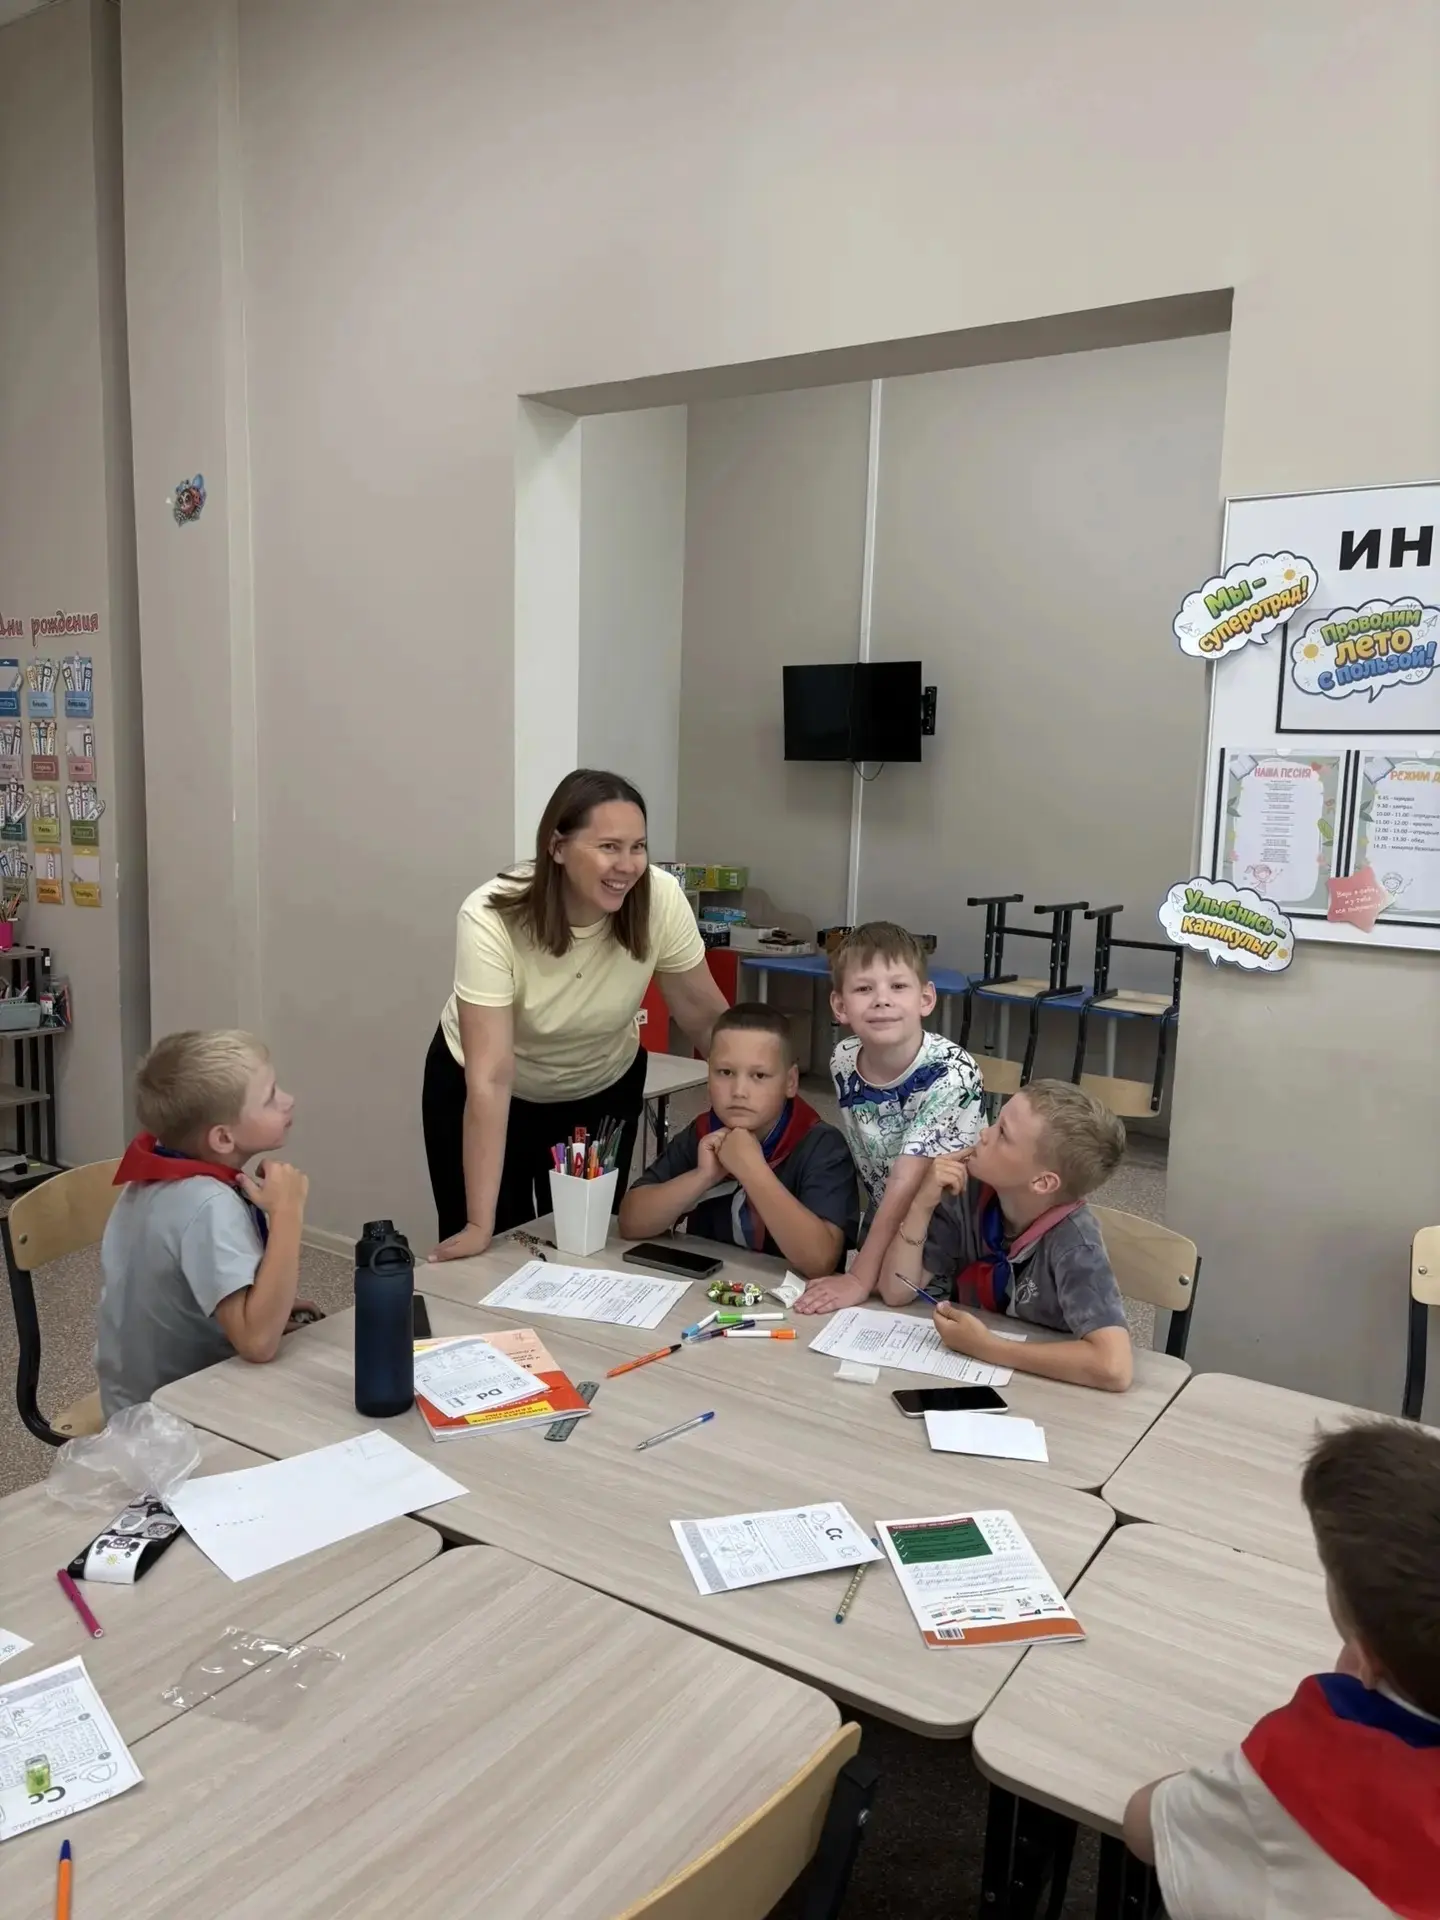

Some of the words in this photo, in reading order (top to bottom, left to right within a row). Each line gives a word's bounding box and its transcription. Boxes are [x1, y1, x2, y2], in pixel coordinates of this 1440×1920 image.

[1339, 525, 1434, 571] ИН
[1199, 576, 1309, 652] суперотряд!
[1204, 580, 1253, 619] Мы
[31, 610, 98, 647] рождения
[1320, 610, 1422, 646] Проводим
[1335, 641, 1437, 686] пользой!
[1254, 767, 1278, 778] НАША
[1280, 768, 1312, 779] ПЕСНЯ
[1390, 770, 1430, 781] РЕЖИМ
[1183, 888, 1274, 936] Улыбнись
[1181, 915, 1278, 960] каникулы!
[476, 1387, 503, 1401] Dd
[28, 1785, 66, 1806] Cc
